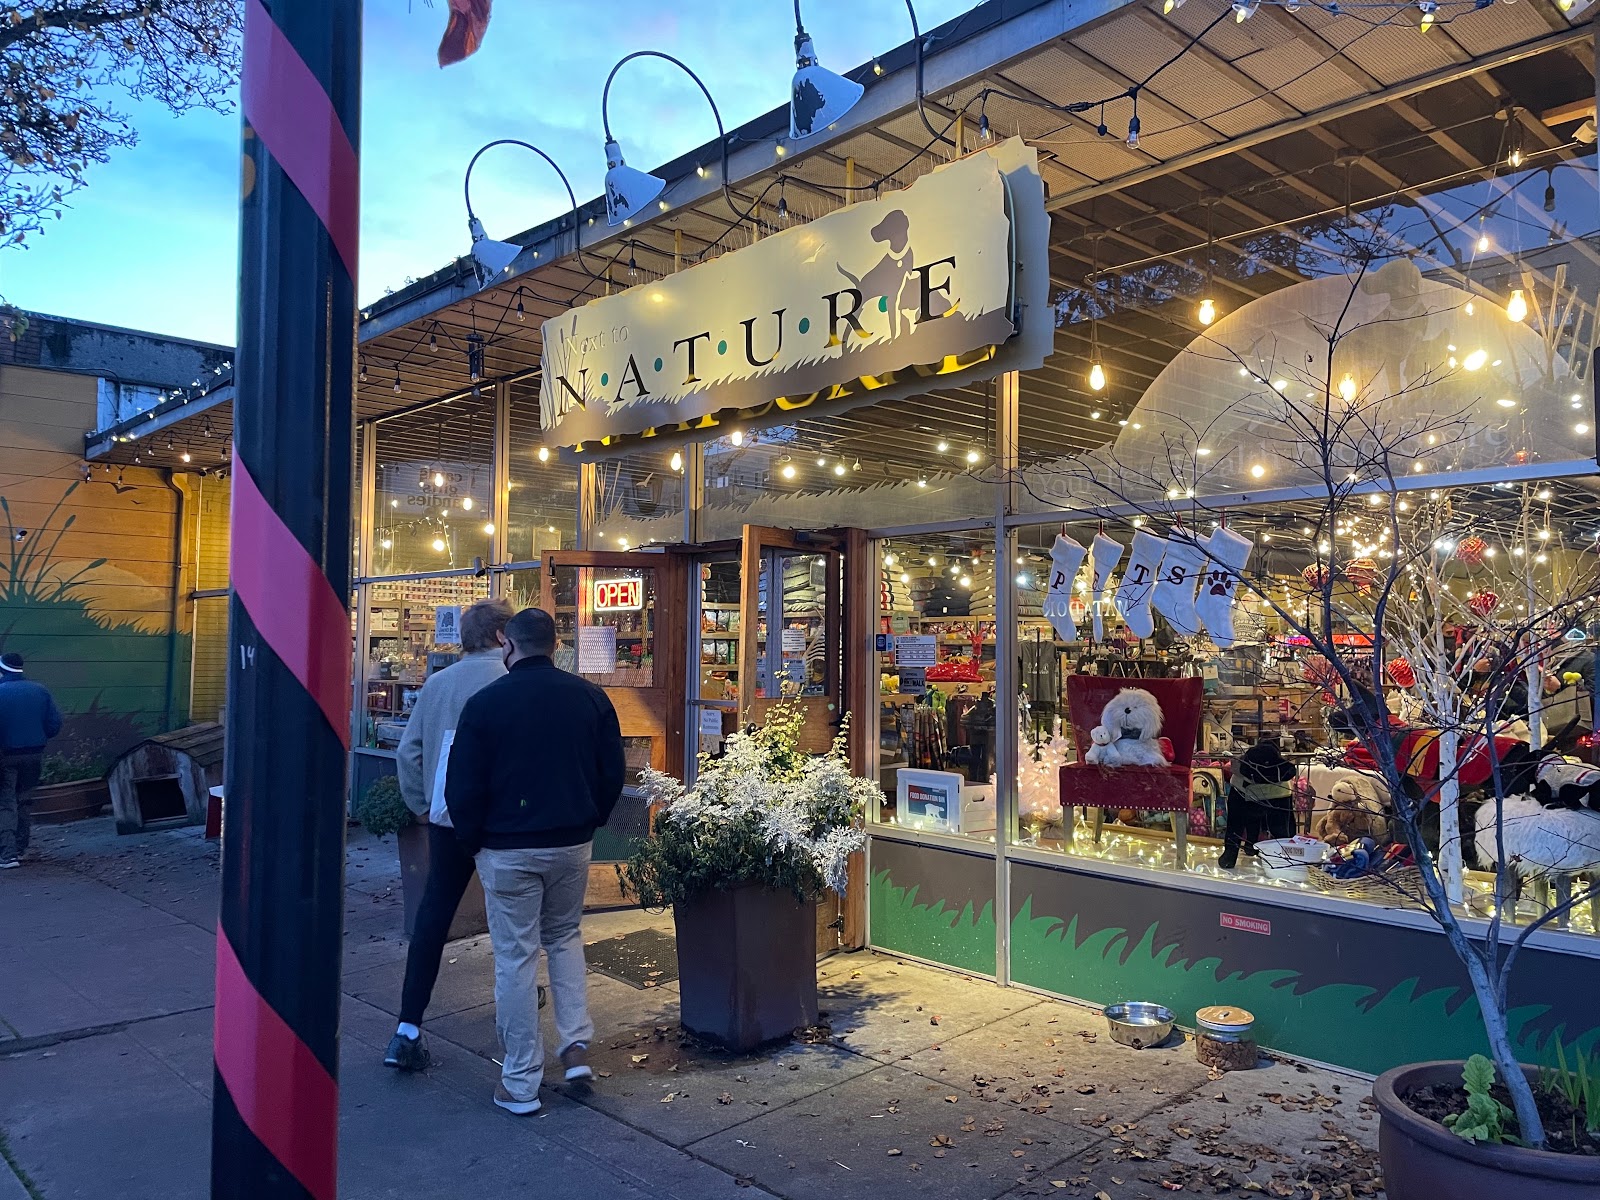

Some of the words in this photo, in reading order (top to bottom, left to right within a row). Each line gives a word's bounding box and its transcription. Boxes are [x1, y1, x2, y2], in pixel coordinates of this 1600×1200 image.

[565, 330, 606, 356] Next
[612, 325, 629, 344] to
[597, 582, 640, 607] OPEN
[920, 793, 938, 802] DONATION
[1222, 916, 1233, 924] NO
[1235, 919, 1268, 931] SMOKING
